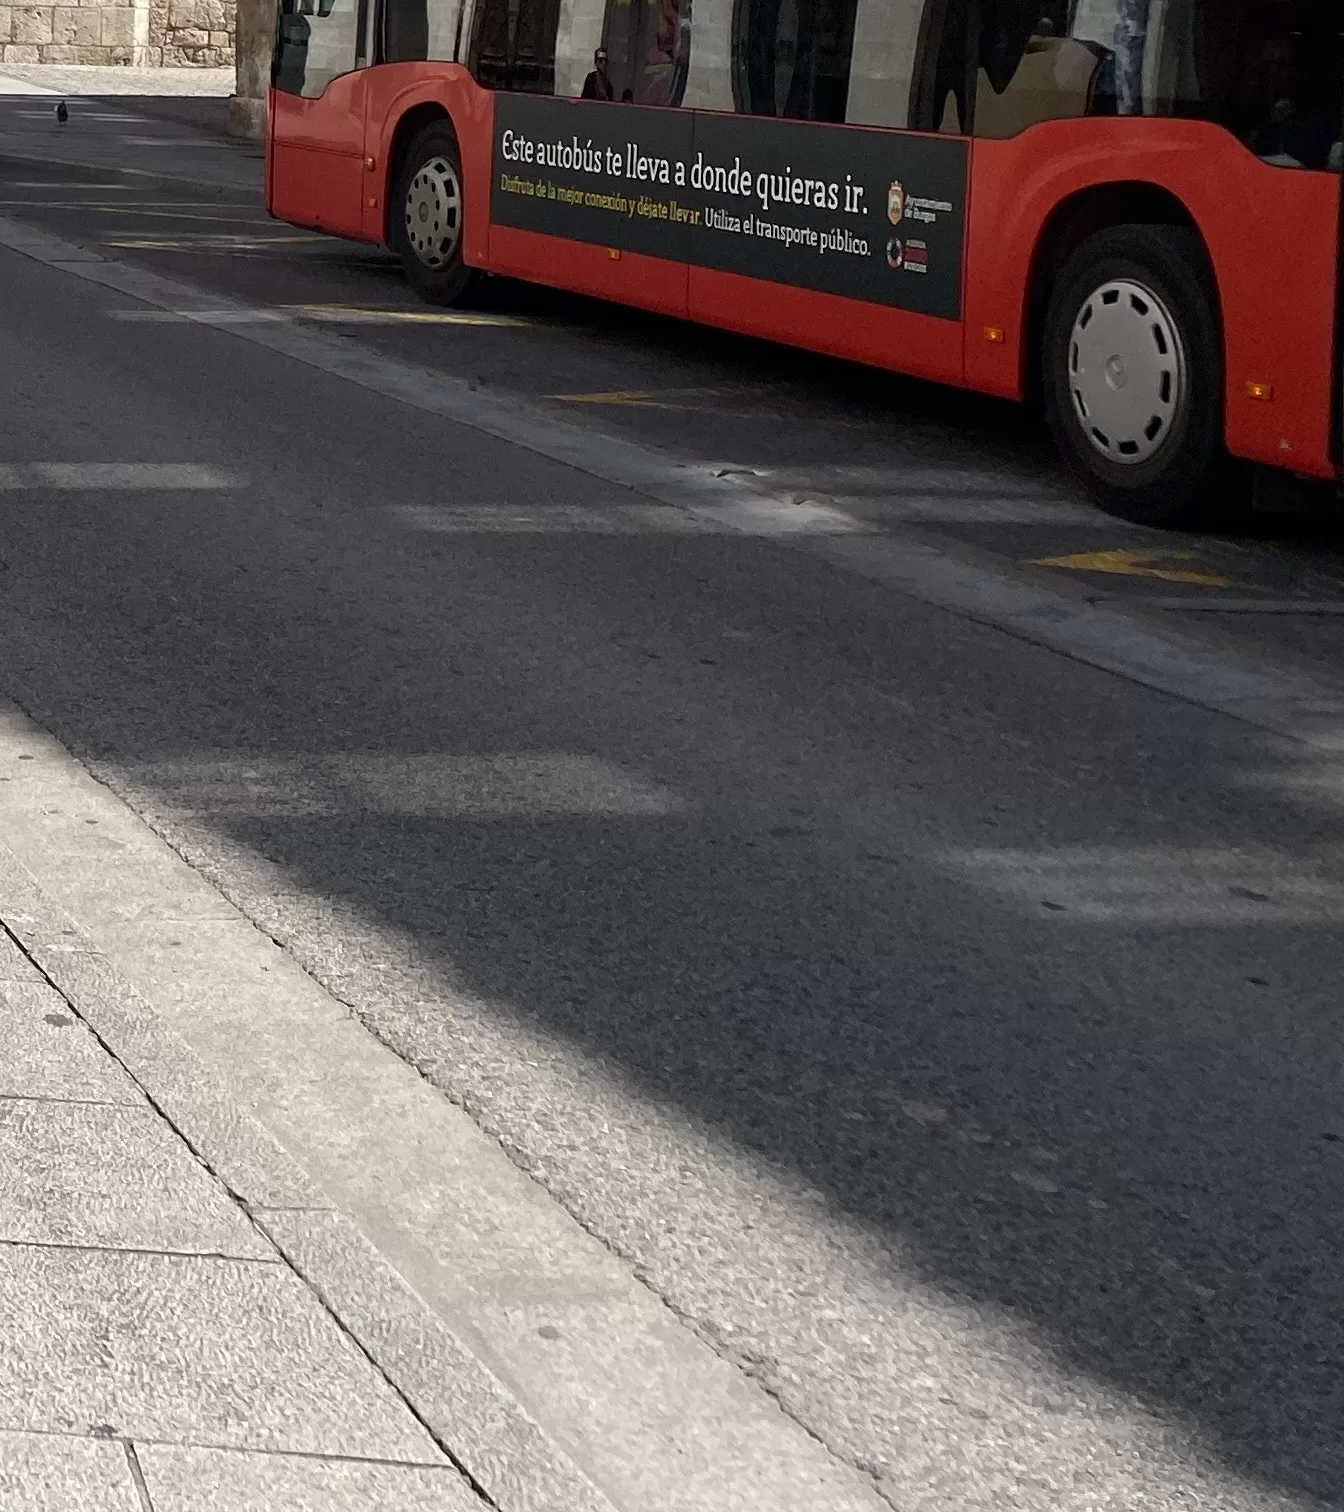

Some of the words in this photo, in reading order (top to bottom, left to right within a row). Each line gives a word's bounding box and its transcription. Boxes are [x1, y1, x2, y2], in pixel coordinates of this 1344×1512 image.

[502, 130, 534, 163] Este
[536, 137, 602, 173] autobús
[606, 146, 623, 176] te
[626, 143, 670, 184] lleva
[674, 161, 686, 186] a
[690, 152, 752, 196] donde
[756, 166, 839, 210] quieras
[844, 174, 868, 215] ir.
[501, 174, 535, 196] Disfruta
[535, 179, 547, 199] de
[548, 181, 556, 201] la
[556, 187, 584, 207] mejor
[584, 191, 628, 213] conexión
[628, 200, 636, 219] y
[637, 195, 669, 220] déjate
[669, 200, 703, 226] llevar.
[704, 207, 741, 233] Utiliza
[742, 214, 754, 235] el
[756, 218, 818, 248] transporte
[819, 229, 872, 257] público.
